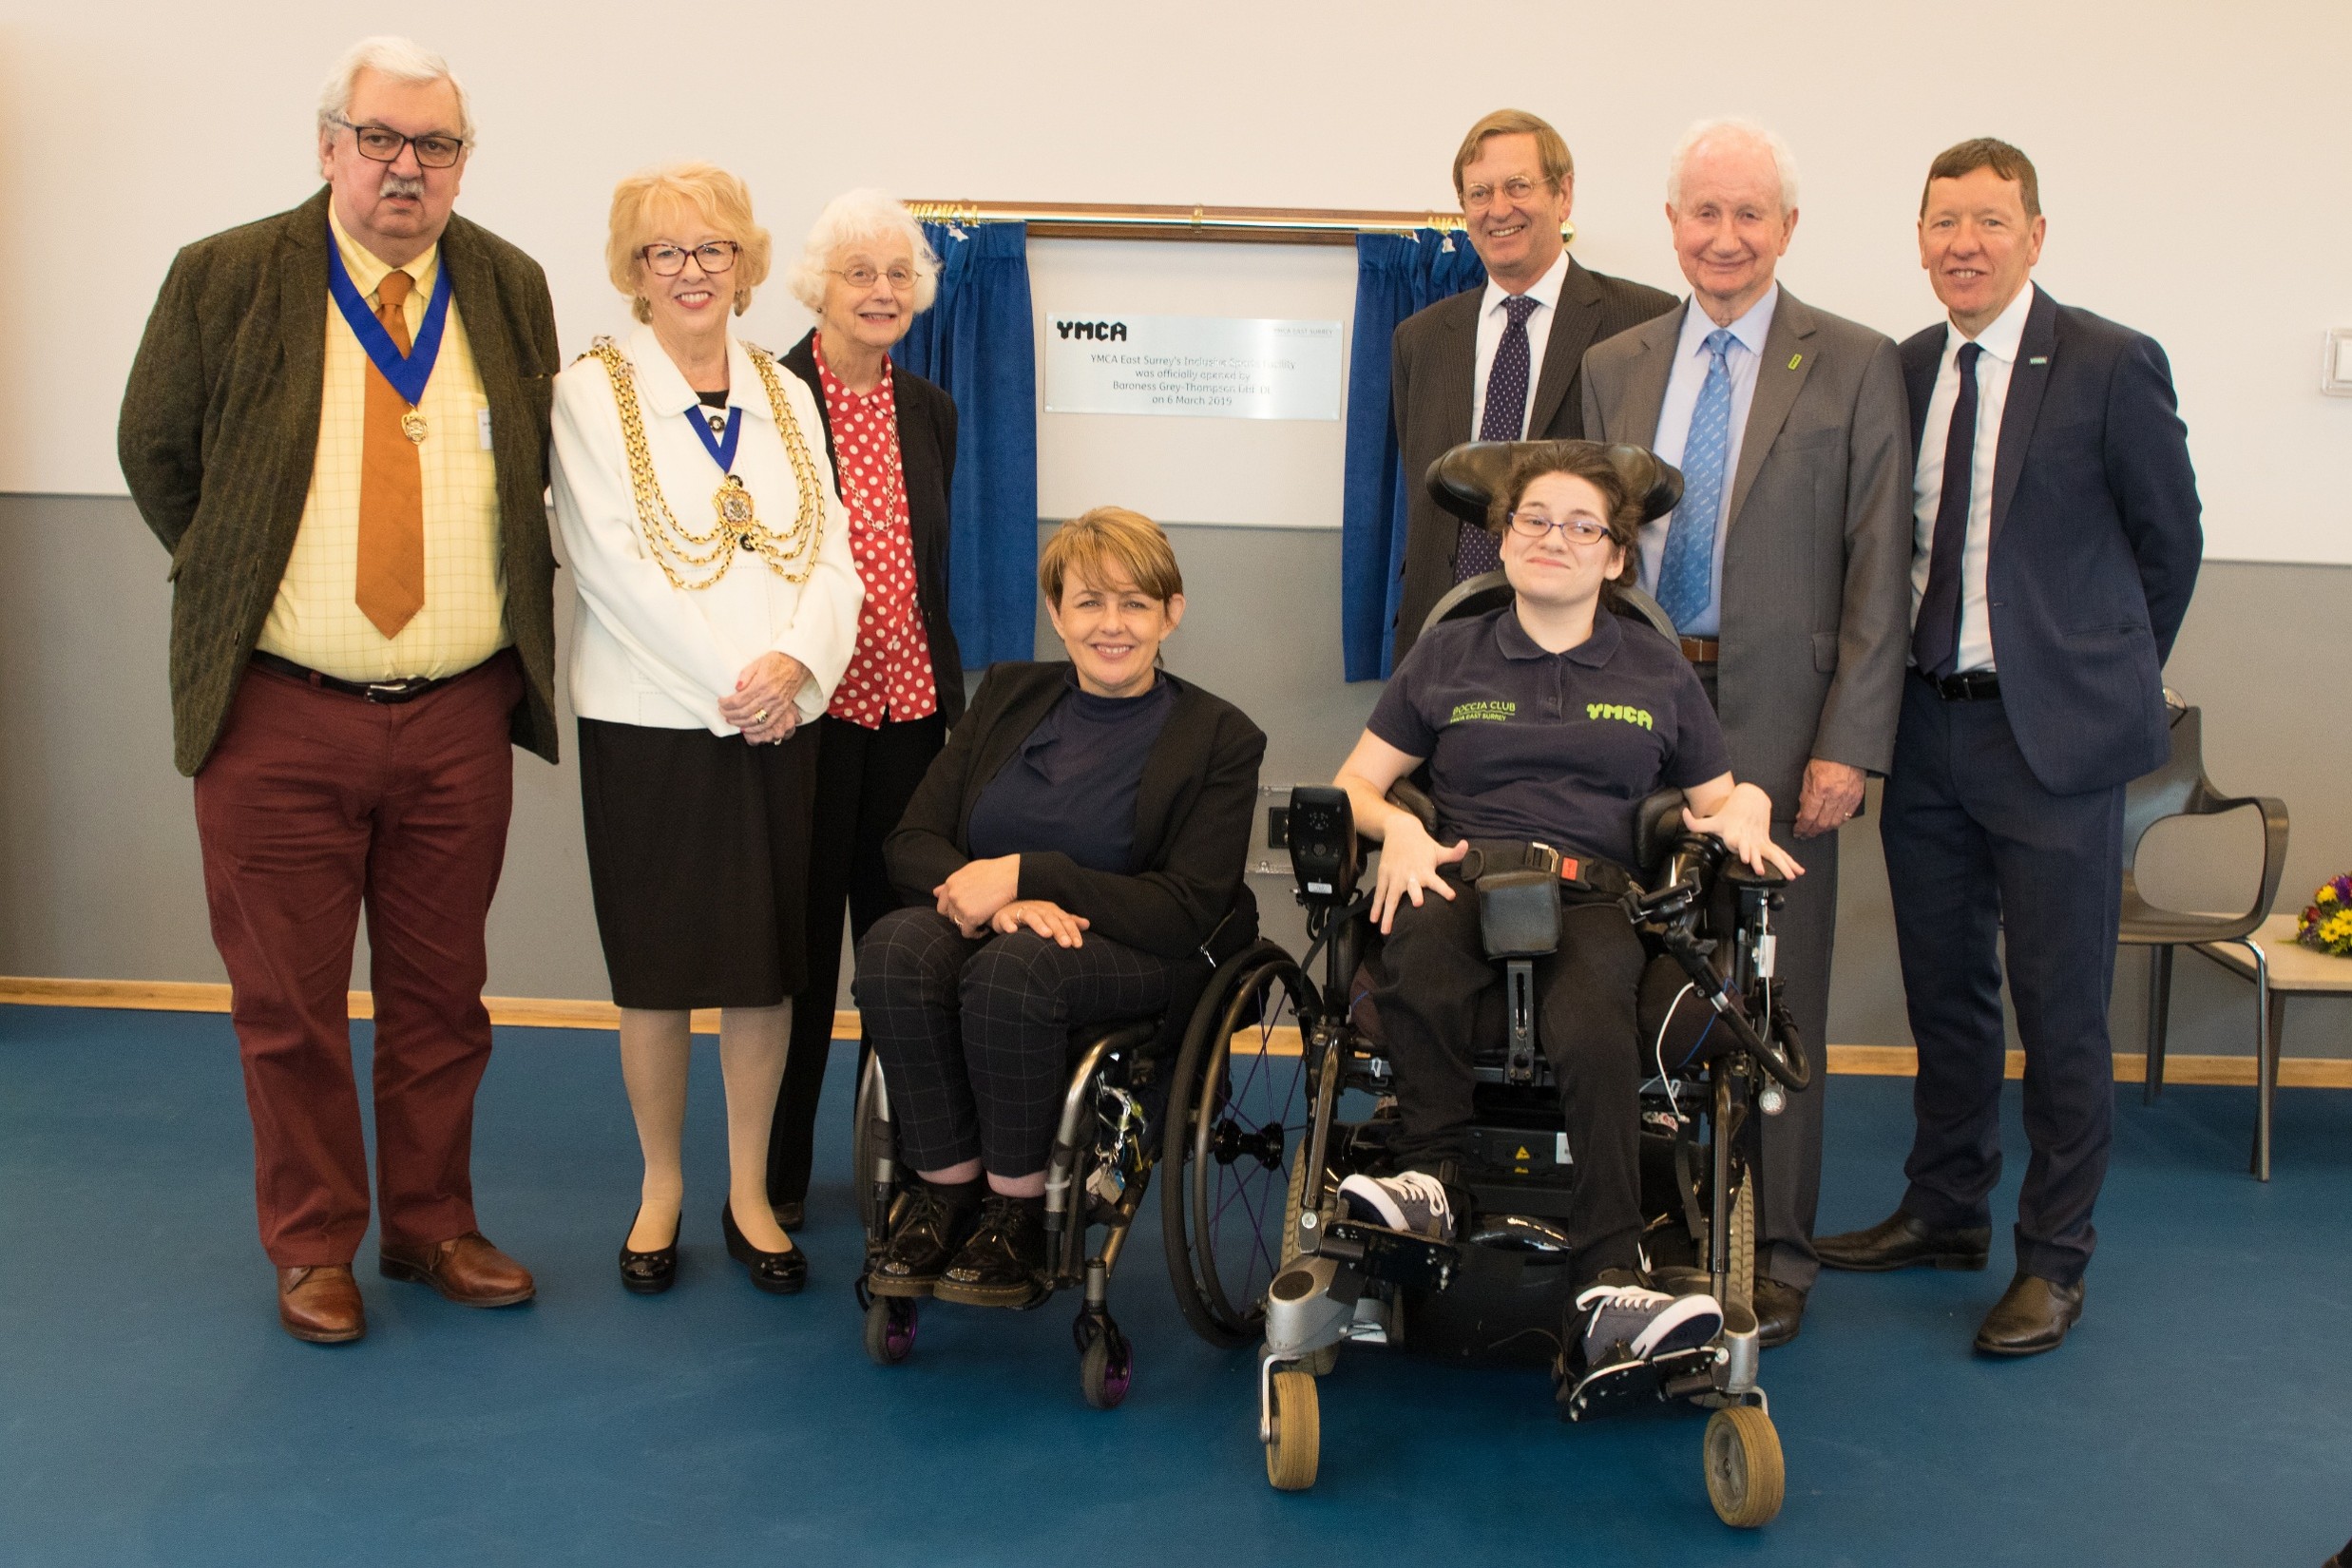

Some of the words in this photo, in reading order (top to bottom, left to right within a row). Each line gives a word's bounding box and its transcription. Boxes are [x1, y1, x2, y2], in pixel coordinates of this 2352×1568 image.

[1057, 320, 1127, 342] YMCA
[1091, 354, 1118, 363] YMCA
[1120, 354, 1140, 365] East
[1143, 355, 1181, 367] Surrey's
[1135, 370, 1155, 378] was
[1157, 369, 1197, 382] officially
[1200, 370, 1236, 381] opened
[1113, 380, 1157, 391] Baroness
[1152, 395, 1164, 404] on
[1167, 395, 1174, 404] 6
[1176, 395, 1206, 406] March
[1209, 396, 1233, 407] 2019
[1452, 701, 1488, 717] BOCCIA
[1490, 700, 1516, 712] CLUB
[1586, 703, 1654, 731] YMCA
